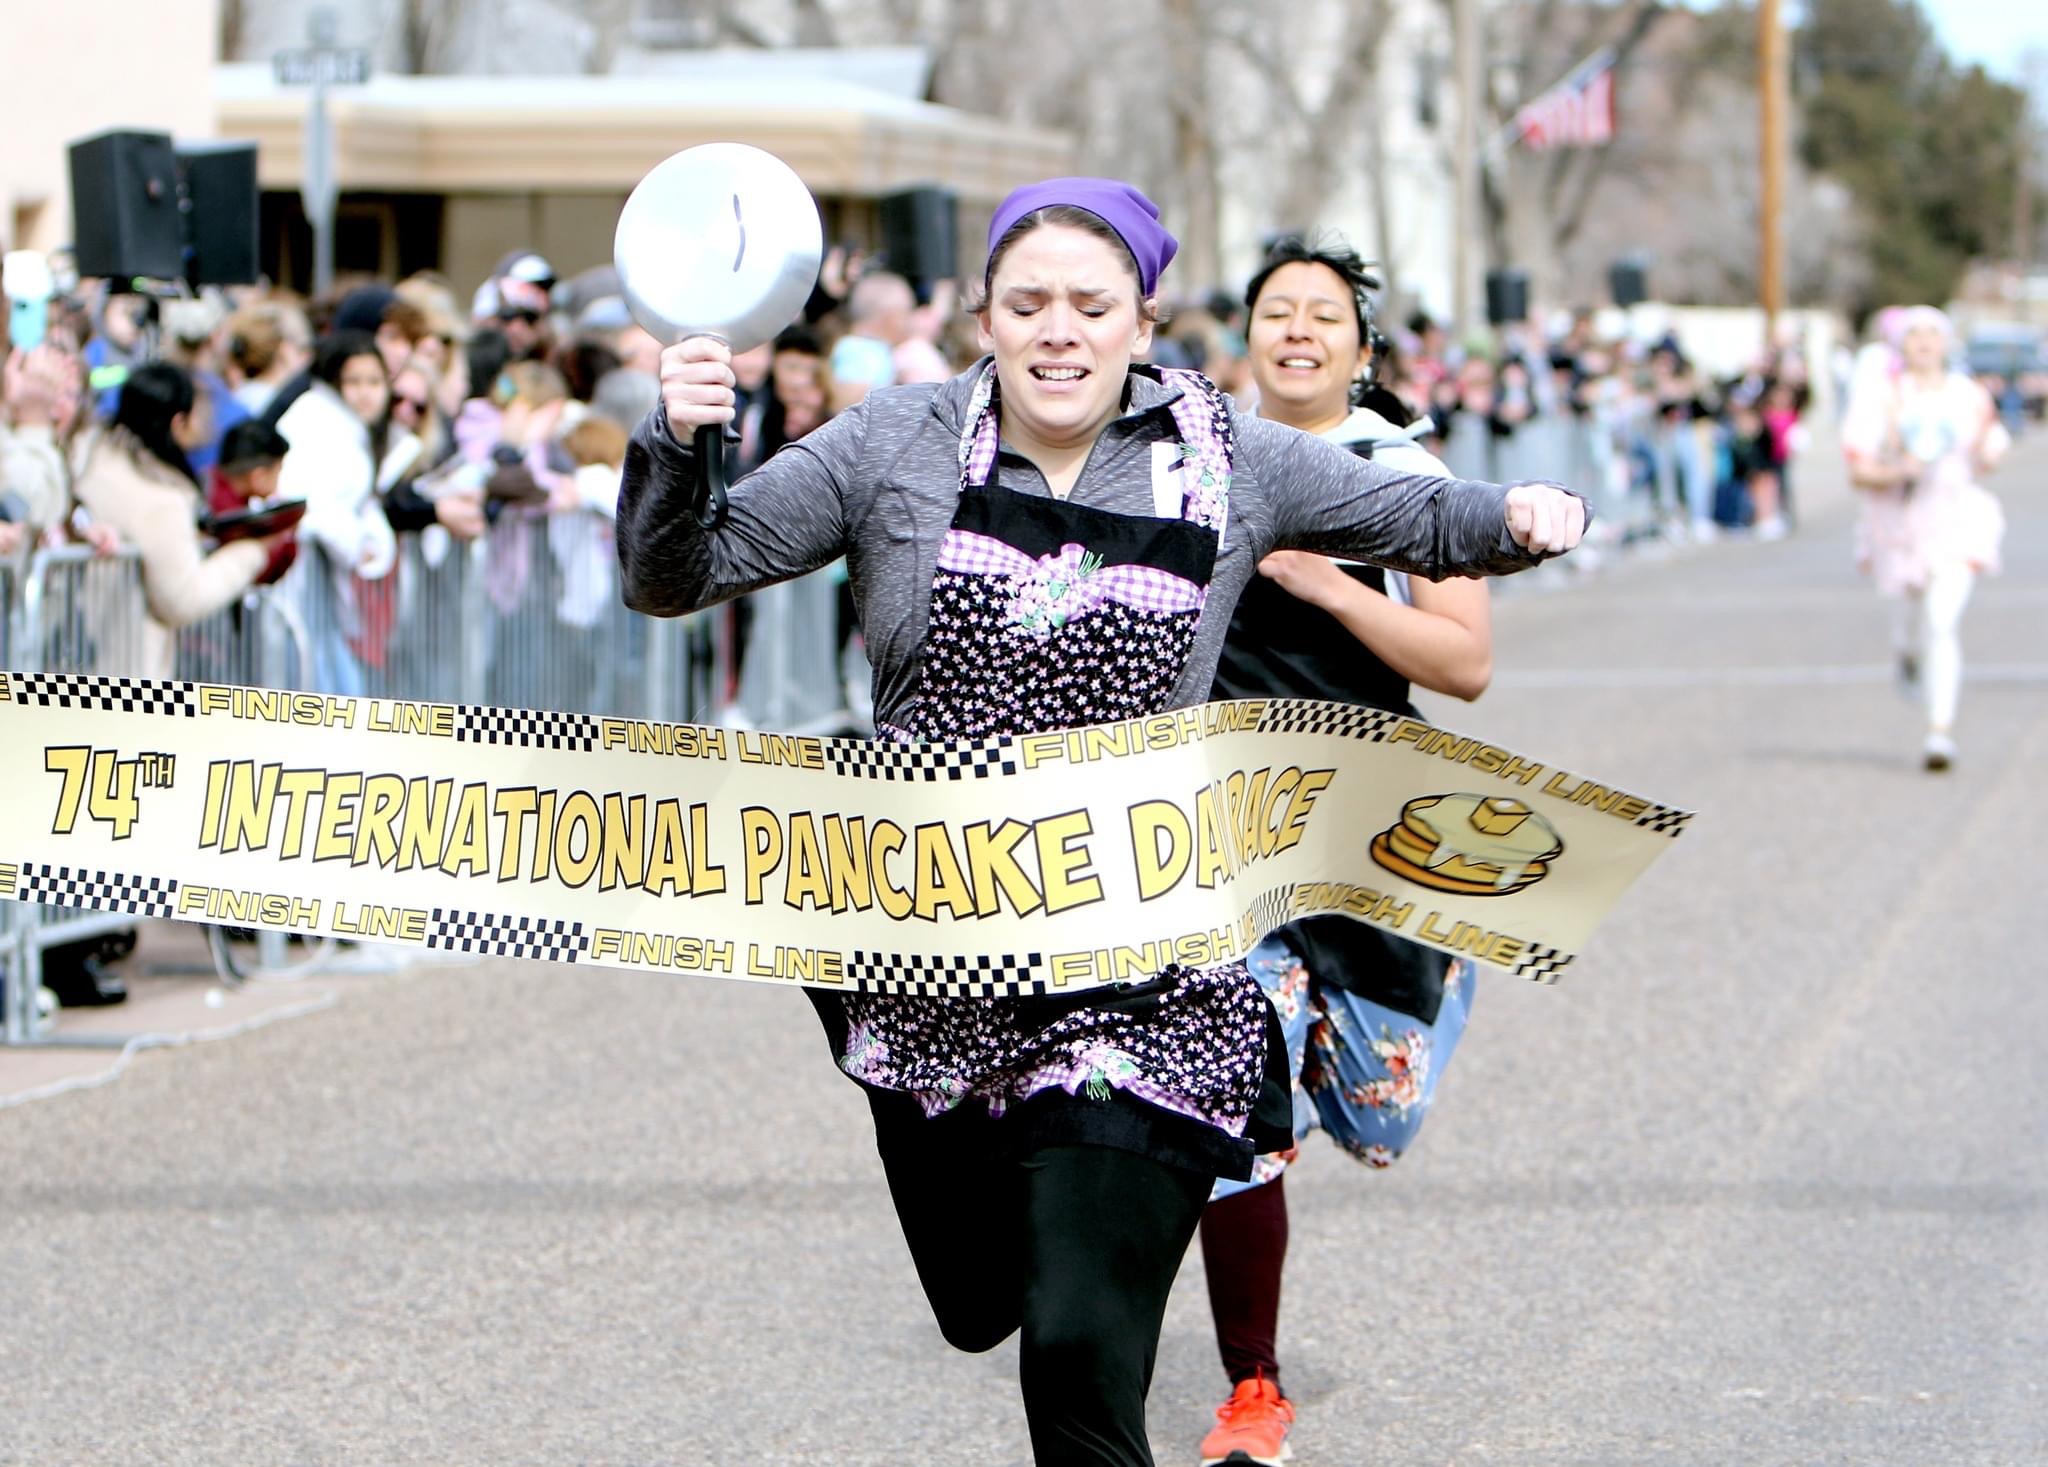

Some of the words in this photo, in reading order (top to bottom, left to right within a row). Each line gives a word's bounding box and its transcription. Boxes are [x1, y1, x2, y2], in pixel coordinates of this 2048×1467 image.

[200, 686, 356, 729] FINISH
[367, 701, 455, 737] LINE
[1022, 708, 1202, 769] FINISH
[1206, 701, 1267, 737] LINE
[602, 719, 727, 760] FINISH
[737, 732, 826, 771] LINE
[1389, 720, 1543, 786] FINISH
[1538, 770, 1652, 822] LINE
[44, 745, 176, 841] 74TH
[199, 759, 726, 898] INTERNATIONAL
[741, 806, 1105, 923] PANCAKE
[1127, 780, 1235, 902] DA
[1227, 766, 1338, 874] RACE
[178, 885, 321, 929] FINISH
[333, 902, 428, 941] LINE
[1290, 881, 1415, 927] FINISH
[1417, 910, 1529, 967] LINE
[591, 928, 734, 973] FINISH
[747, 943, 845, 984] LINE
[1050, 924, 1236, 987] FINISH
